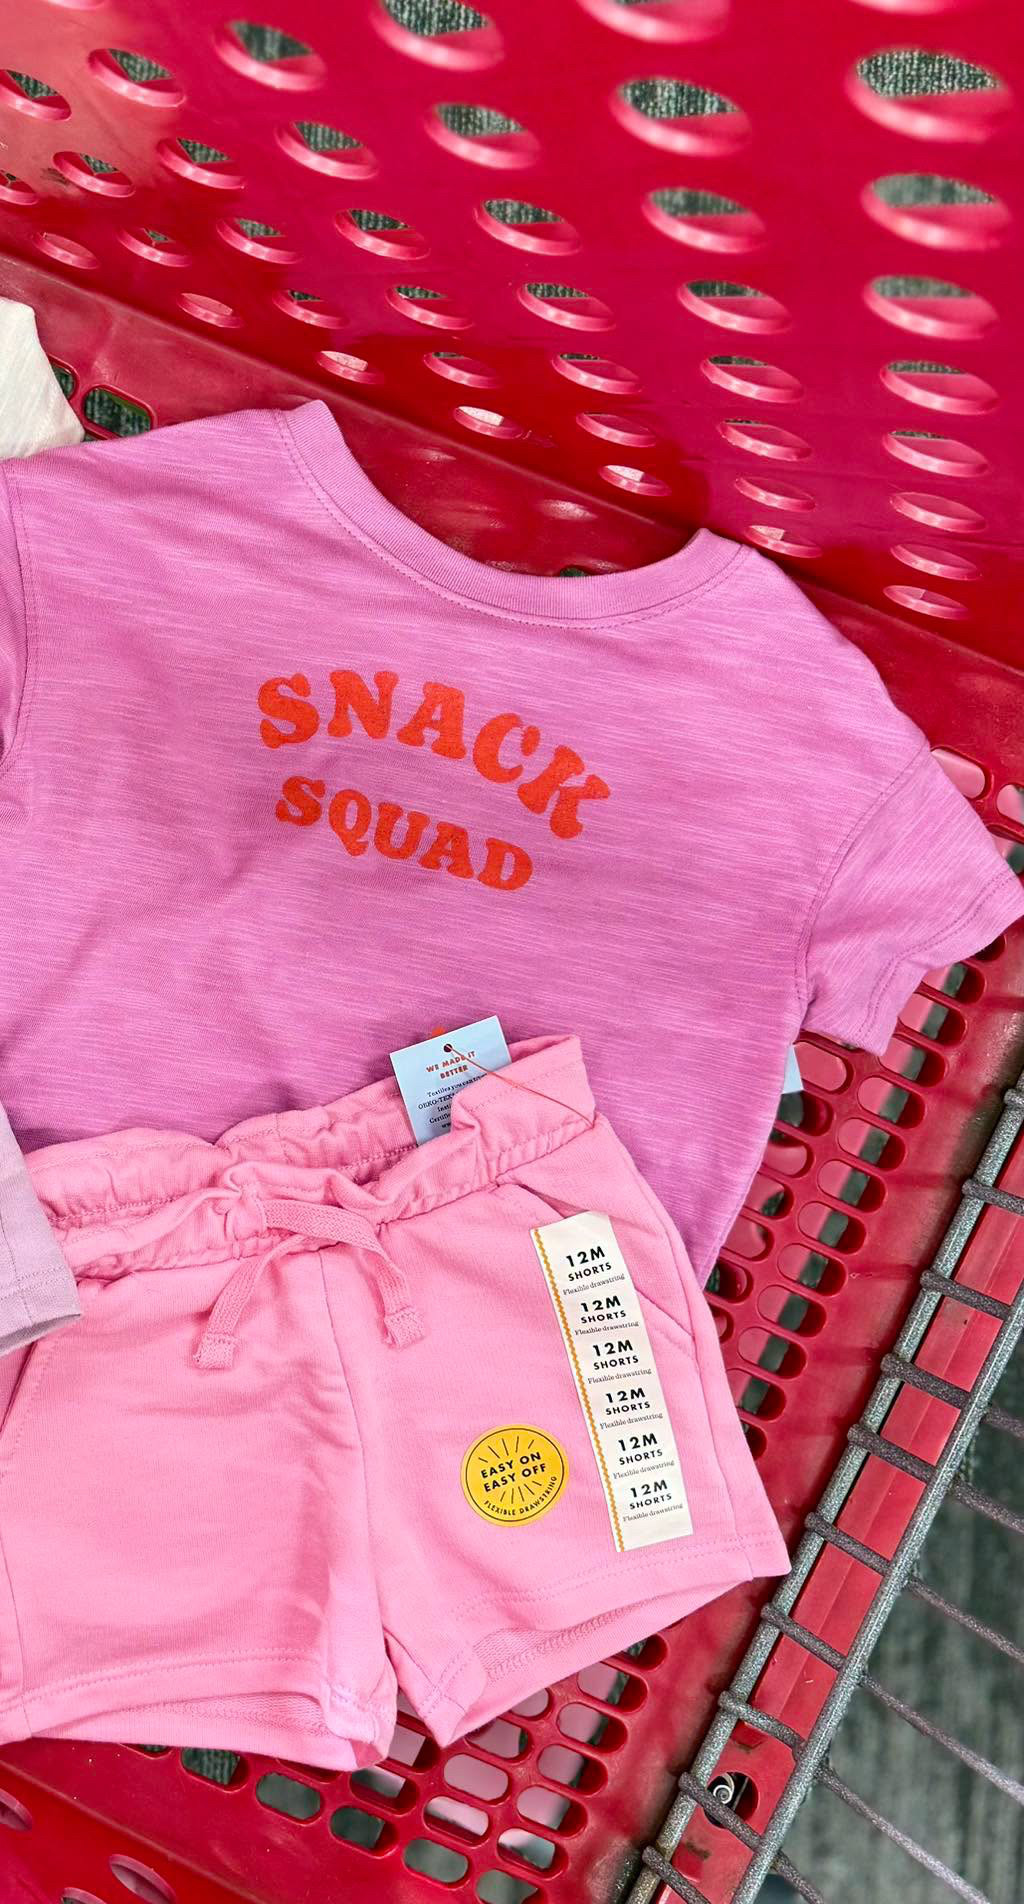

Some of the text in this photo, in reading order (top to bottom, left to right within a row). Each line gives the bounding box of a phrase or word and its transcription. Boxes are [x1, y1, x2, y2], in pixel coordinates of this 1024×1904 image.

[258, 670, 610, 839] SNACK
[276, 776, 533, 891] SQUAD
[426, 1064, 439, 1072] WE
[442, 1055, 465, 1067] MADE
[440, 1065, 468, 1079] BETTER
[566, 1246, 605, 1268] 12M
[569, 1262, 611, 1281] SHORTS
[563, 1283, 589, 1295] Flexible
[581, 1295, 621, 1312] 12M
[581, 1310, 626, 1323] SHORTS
[575, 1327, 601, 1335] Flexible
[593, 1340, 633, 1357] 12M
[594, 1355, 639, 1370] SHORTS
[588, 1374, 614, 1384] Flexible
[606, 1388, 645, 1403] 12M
[606, 1401, 650, 1415] SHORTS
[600, 1419, 626, 1430] Flexible
[618, 1433, 657, 1451] 12M
[481, 1452, 541, 1478] EASY ON
[619, 1449, 662, 1465] SHORTS
[484, 1463, 546, 1492] EASY OFF
[613, 1469, 639, 1479] Flexible
[484, 1476, 557, 1515] FLEXIBLE DRAWSTRING
[631, 1480, 668, 1498] 12M
[630, 1493, 672, 1510] SHORTS
[623, 1512, 648, 1522] Flexible
